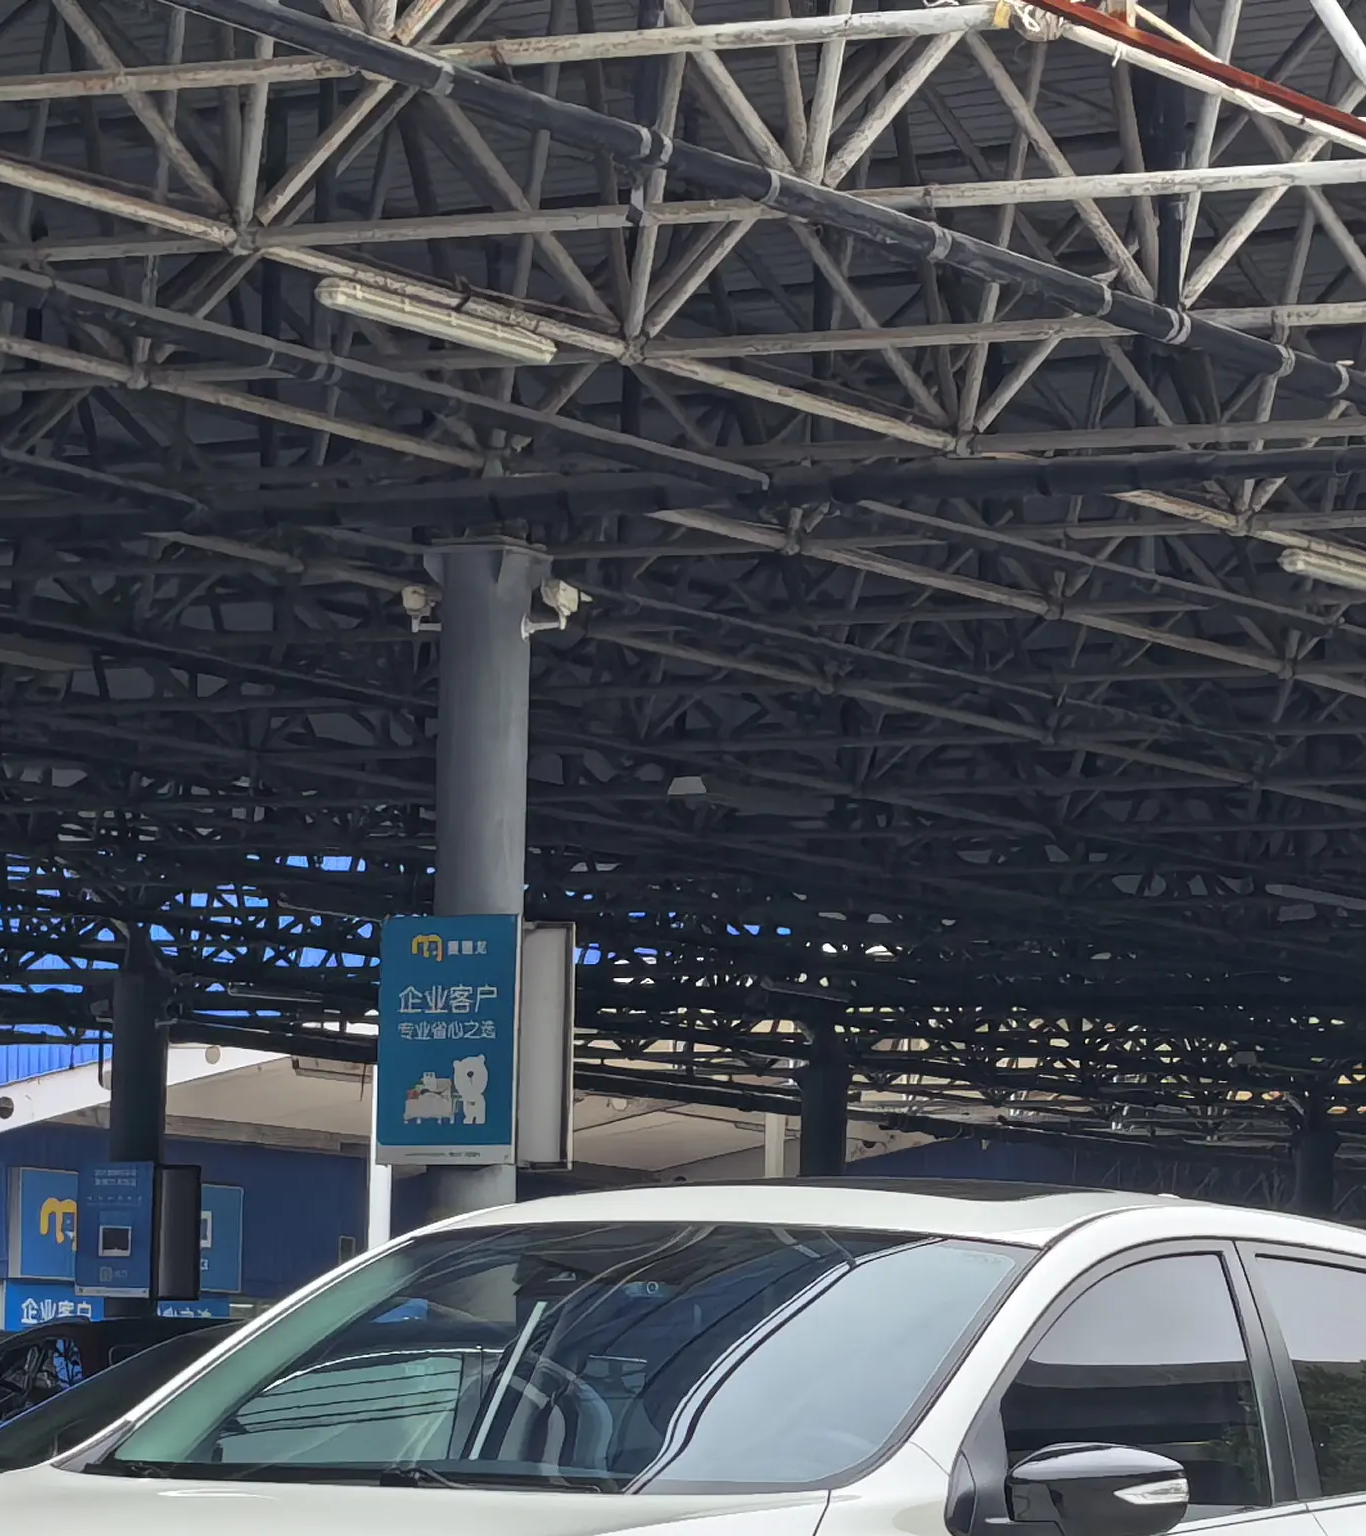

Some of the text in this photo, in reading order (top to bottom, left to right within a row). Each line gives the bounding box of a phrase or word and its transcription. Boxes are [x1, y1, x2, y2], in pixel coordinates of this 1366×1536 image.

[397, 984, 498, 1014] 企业客户
[397, 1020, 496, 1040] 专业省心之选
